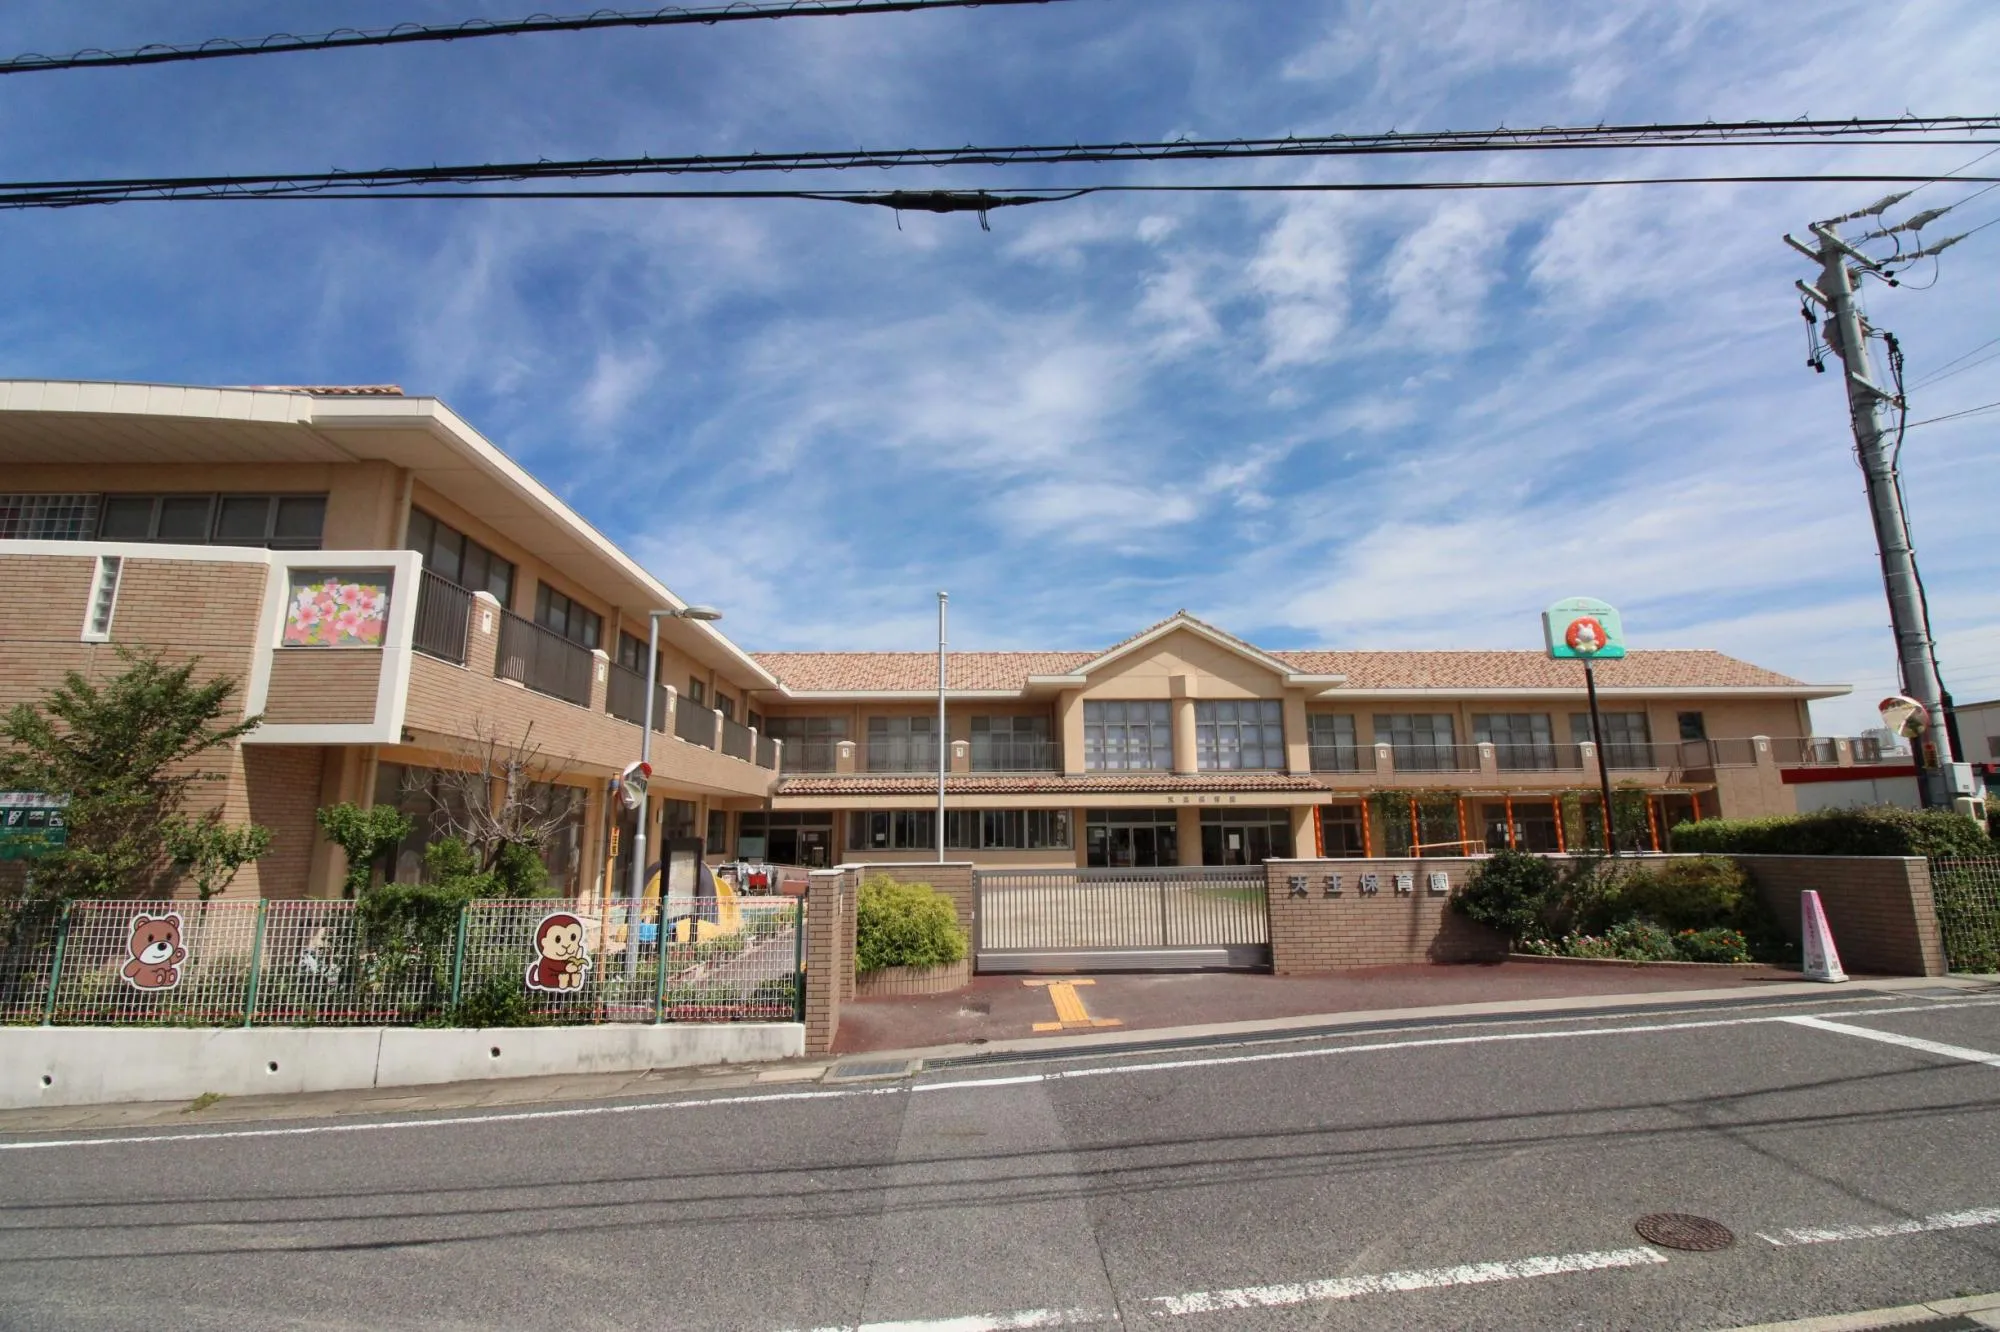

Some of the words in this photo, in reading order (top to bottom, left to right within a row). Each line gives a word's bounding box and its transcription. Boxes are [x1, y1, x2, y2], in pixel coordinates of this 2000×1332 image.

[1290, 872, 1449, 893] 天王保育園
